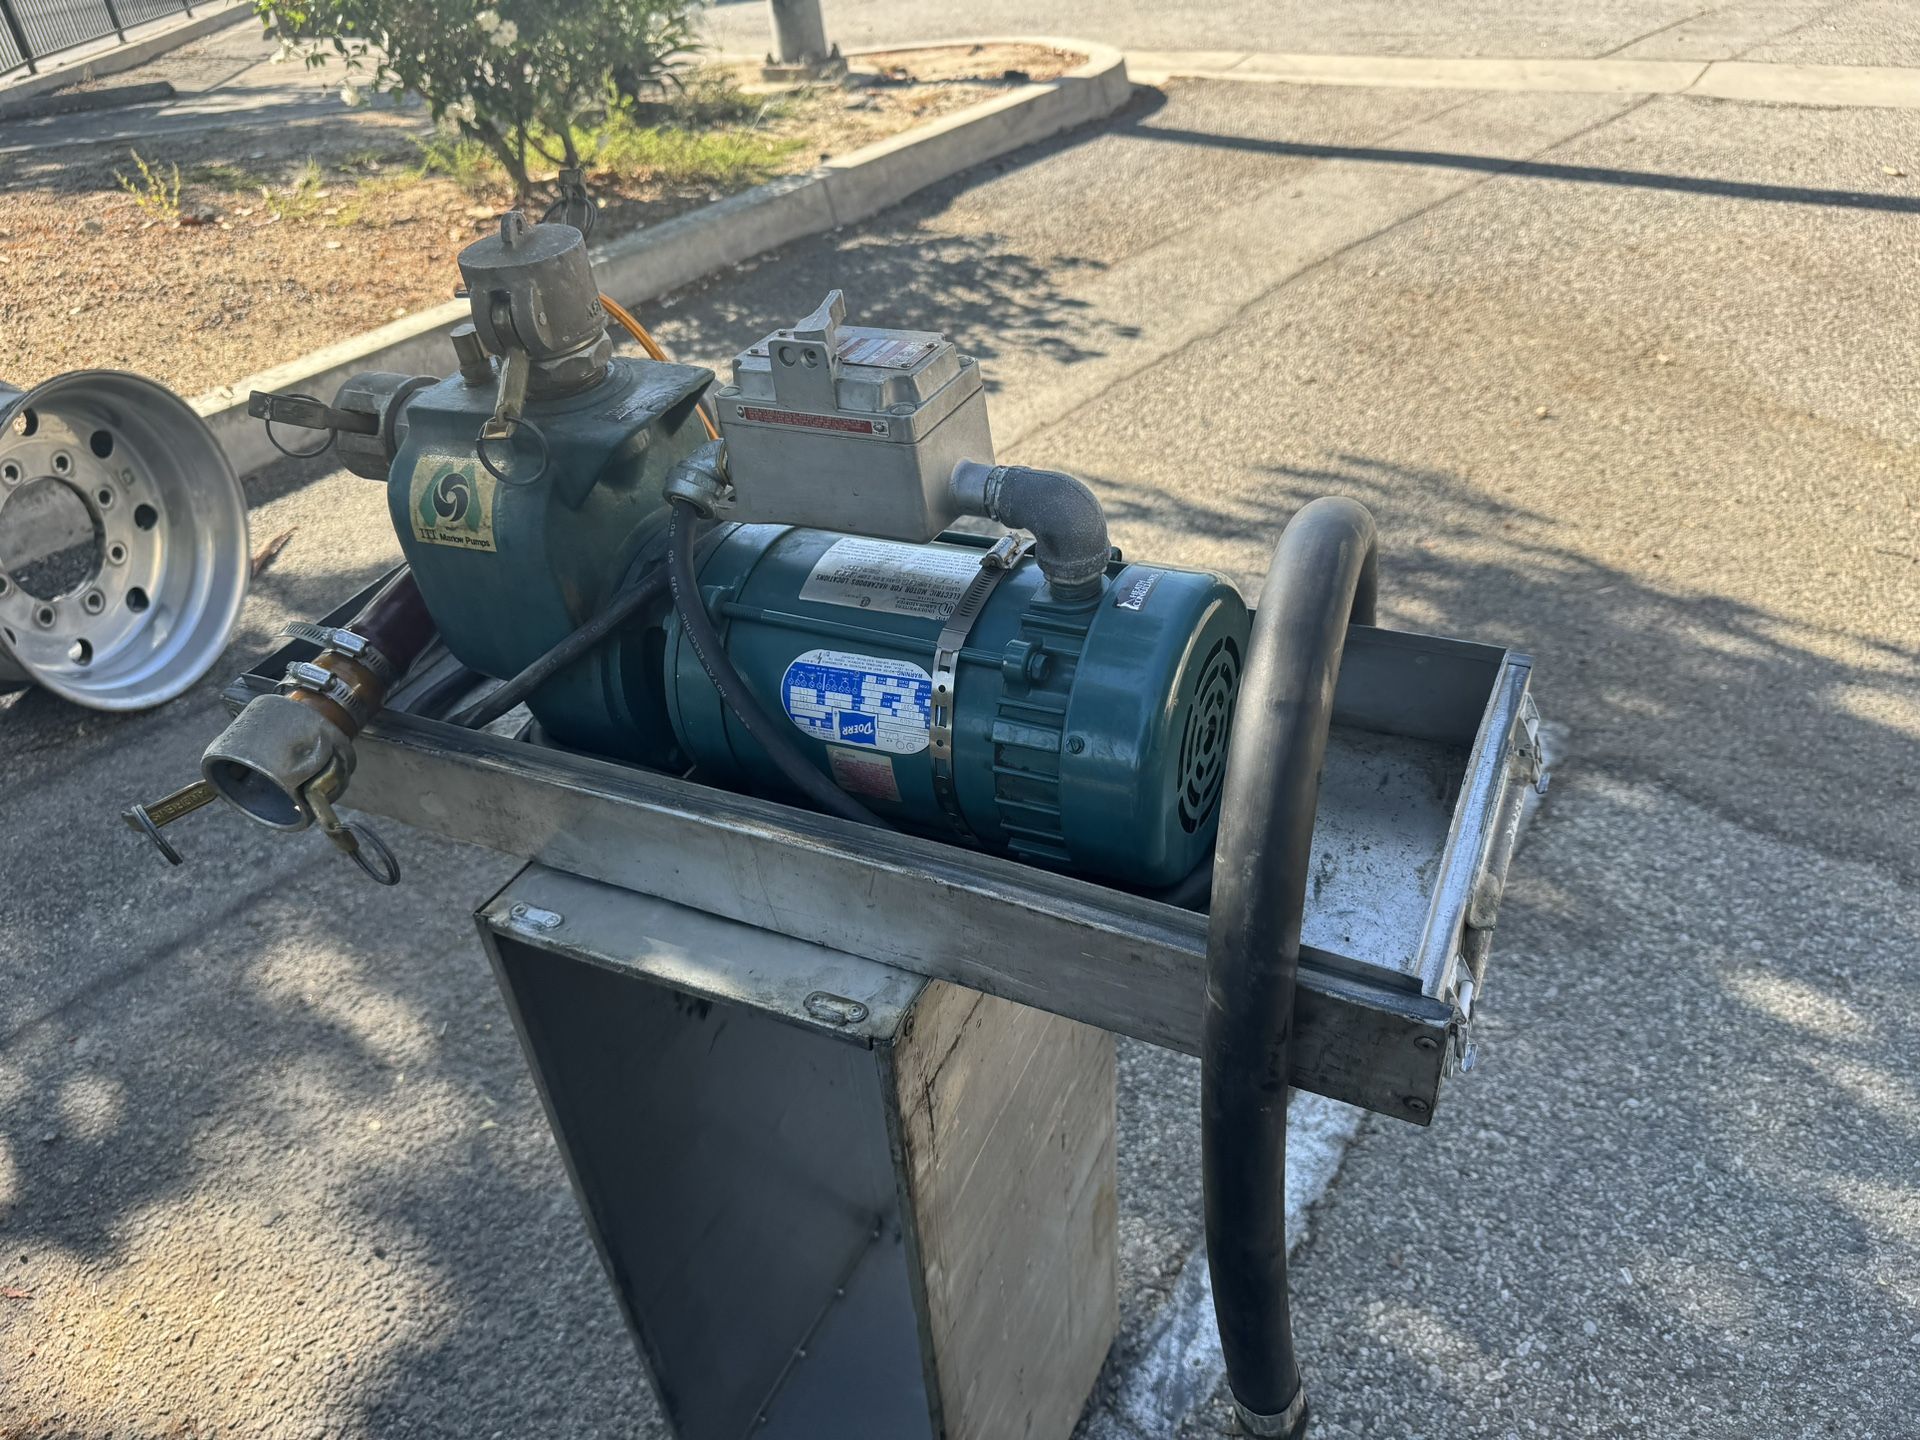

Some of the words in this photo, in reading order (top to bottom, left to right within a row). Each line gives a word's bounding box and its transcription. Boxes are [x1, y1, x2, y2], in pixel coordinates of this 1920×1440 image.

[465, 537, 490, 548] Pumps
[815, 573, 849, 584] LOCATIONS
[850, 578, 888, 589] HAZARDOUS
[888, 583, 902, 591] FOR
[903, 585, 927, 595] MOTOR
[928, 588, 961, 600] ELECTRIC
[681, 613, 705, 660] ELECTRIC
[896, 669, 923, 679] WARNING
[841, 720, 873, 735] DOERR
